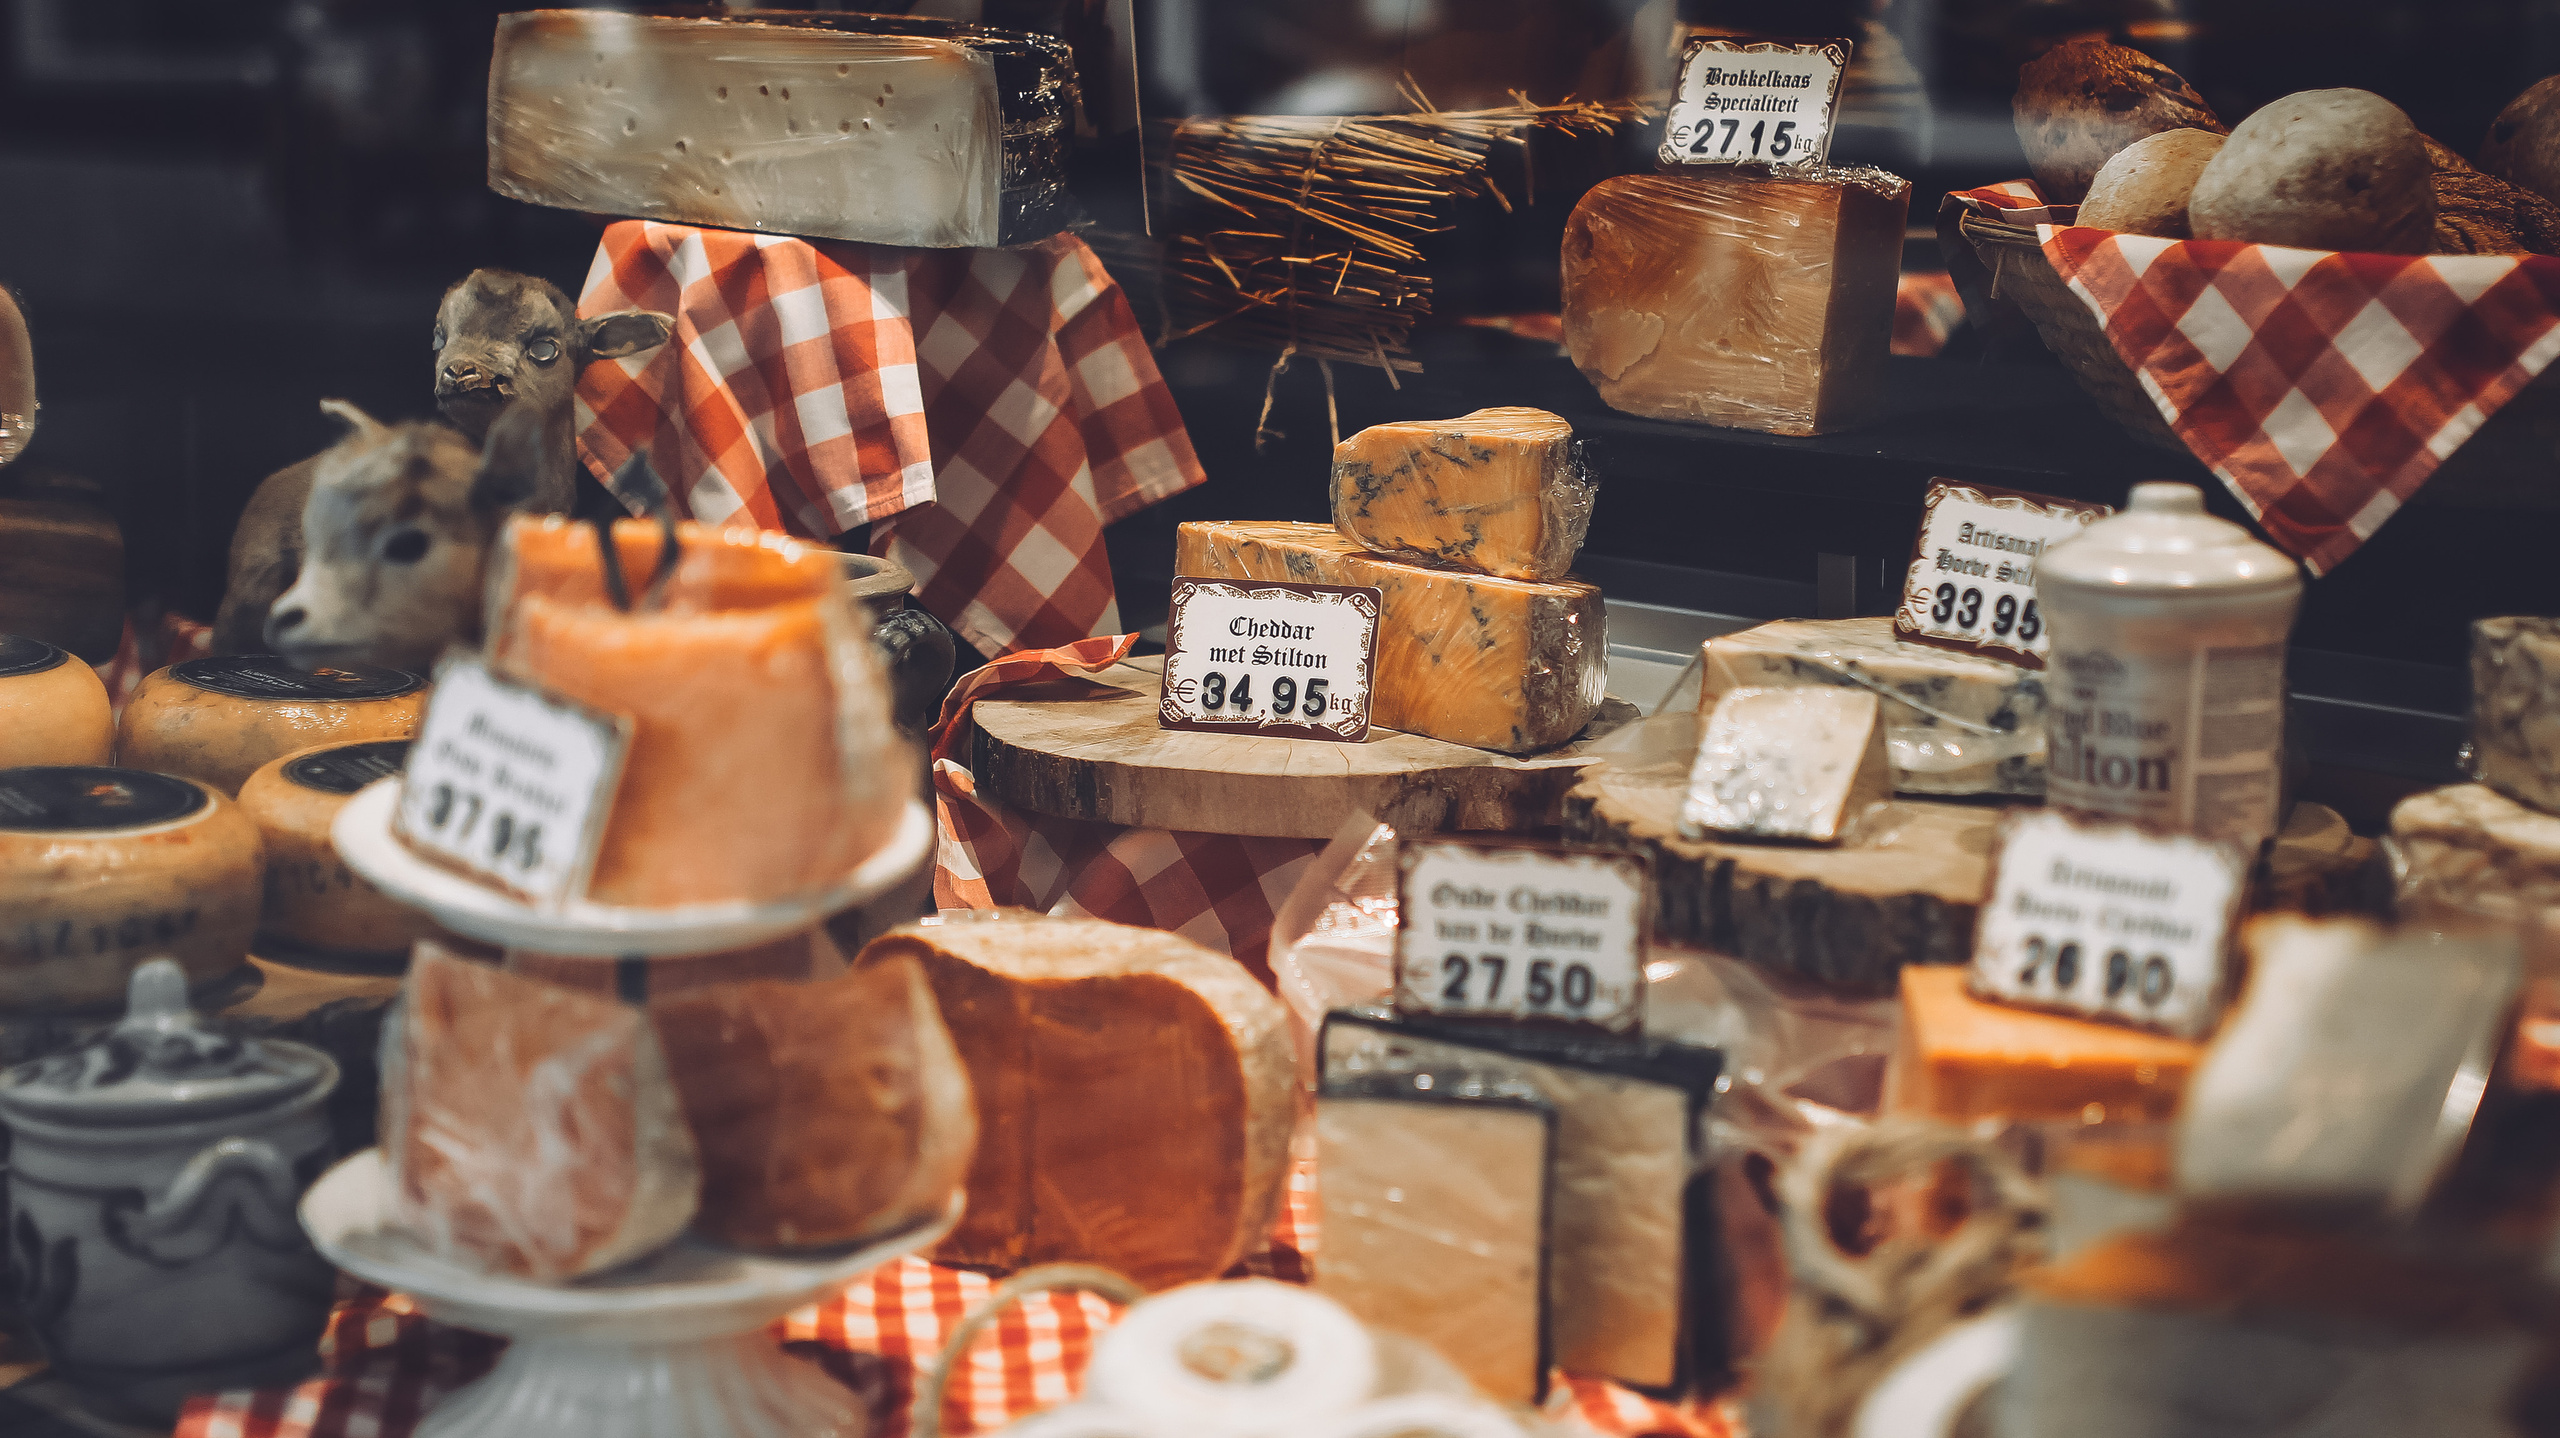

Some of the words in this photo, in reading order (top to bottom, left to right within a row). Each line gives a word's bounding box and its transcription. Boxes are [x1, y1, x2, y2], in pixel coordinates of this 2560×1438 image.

[1703, 67, 1813, 90] Brokkelkaas
[1703, 92, 1800, 113] Specialiteit
[1228, 615, 1316, 642] Cheddar
[1209, 646, 1246, 664] met
[1251, 645, 1328, 669] Stilton
